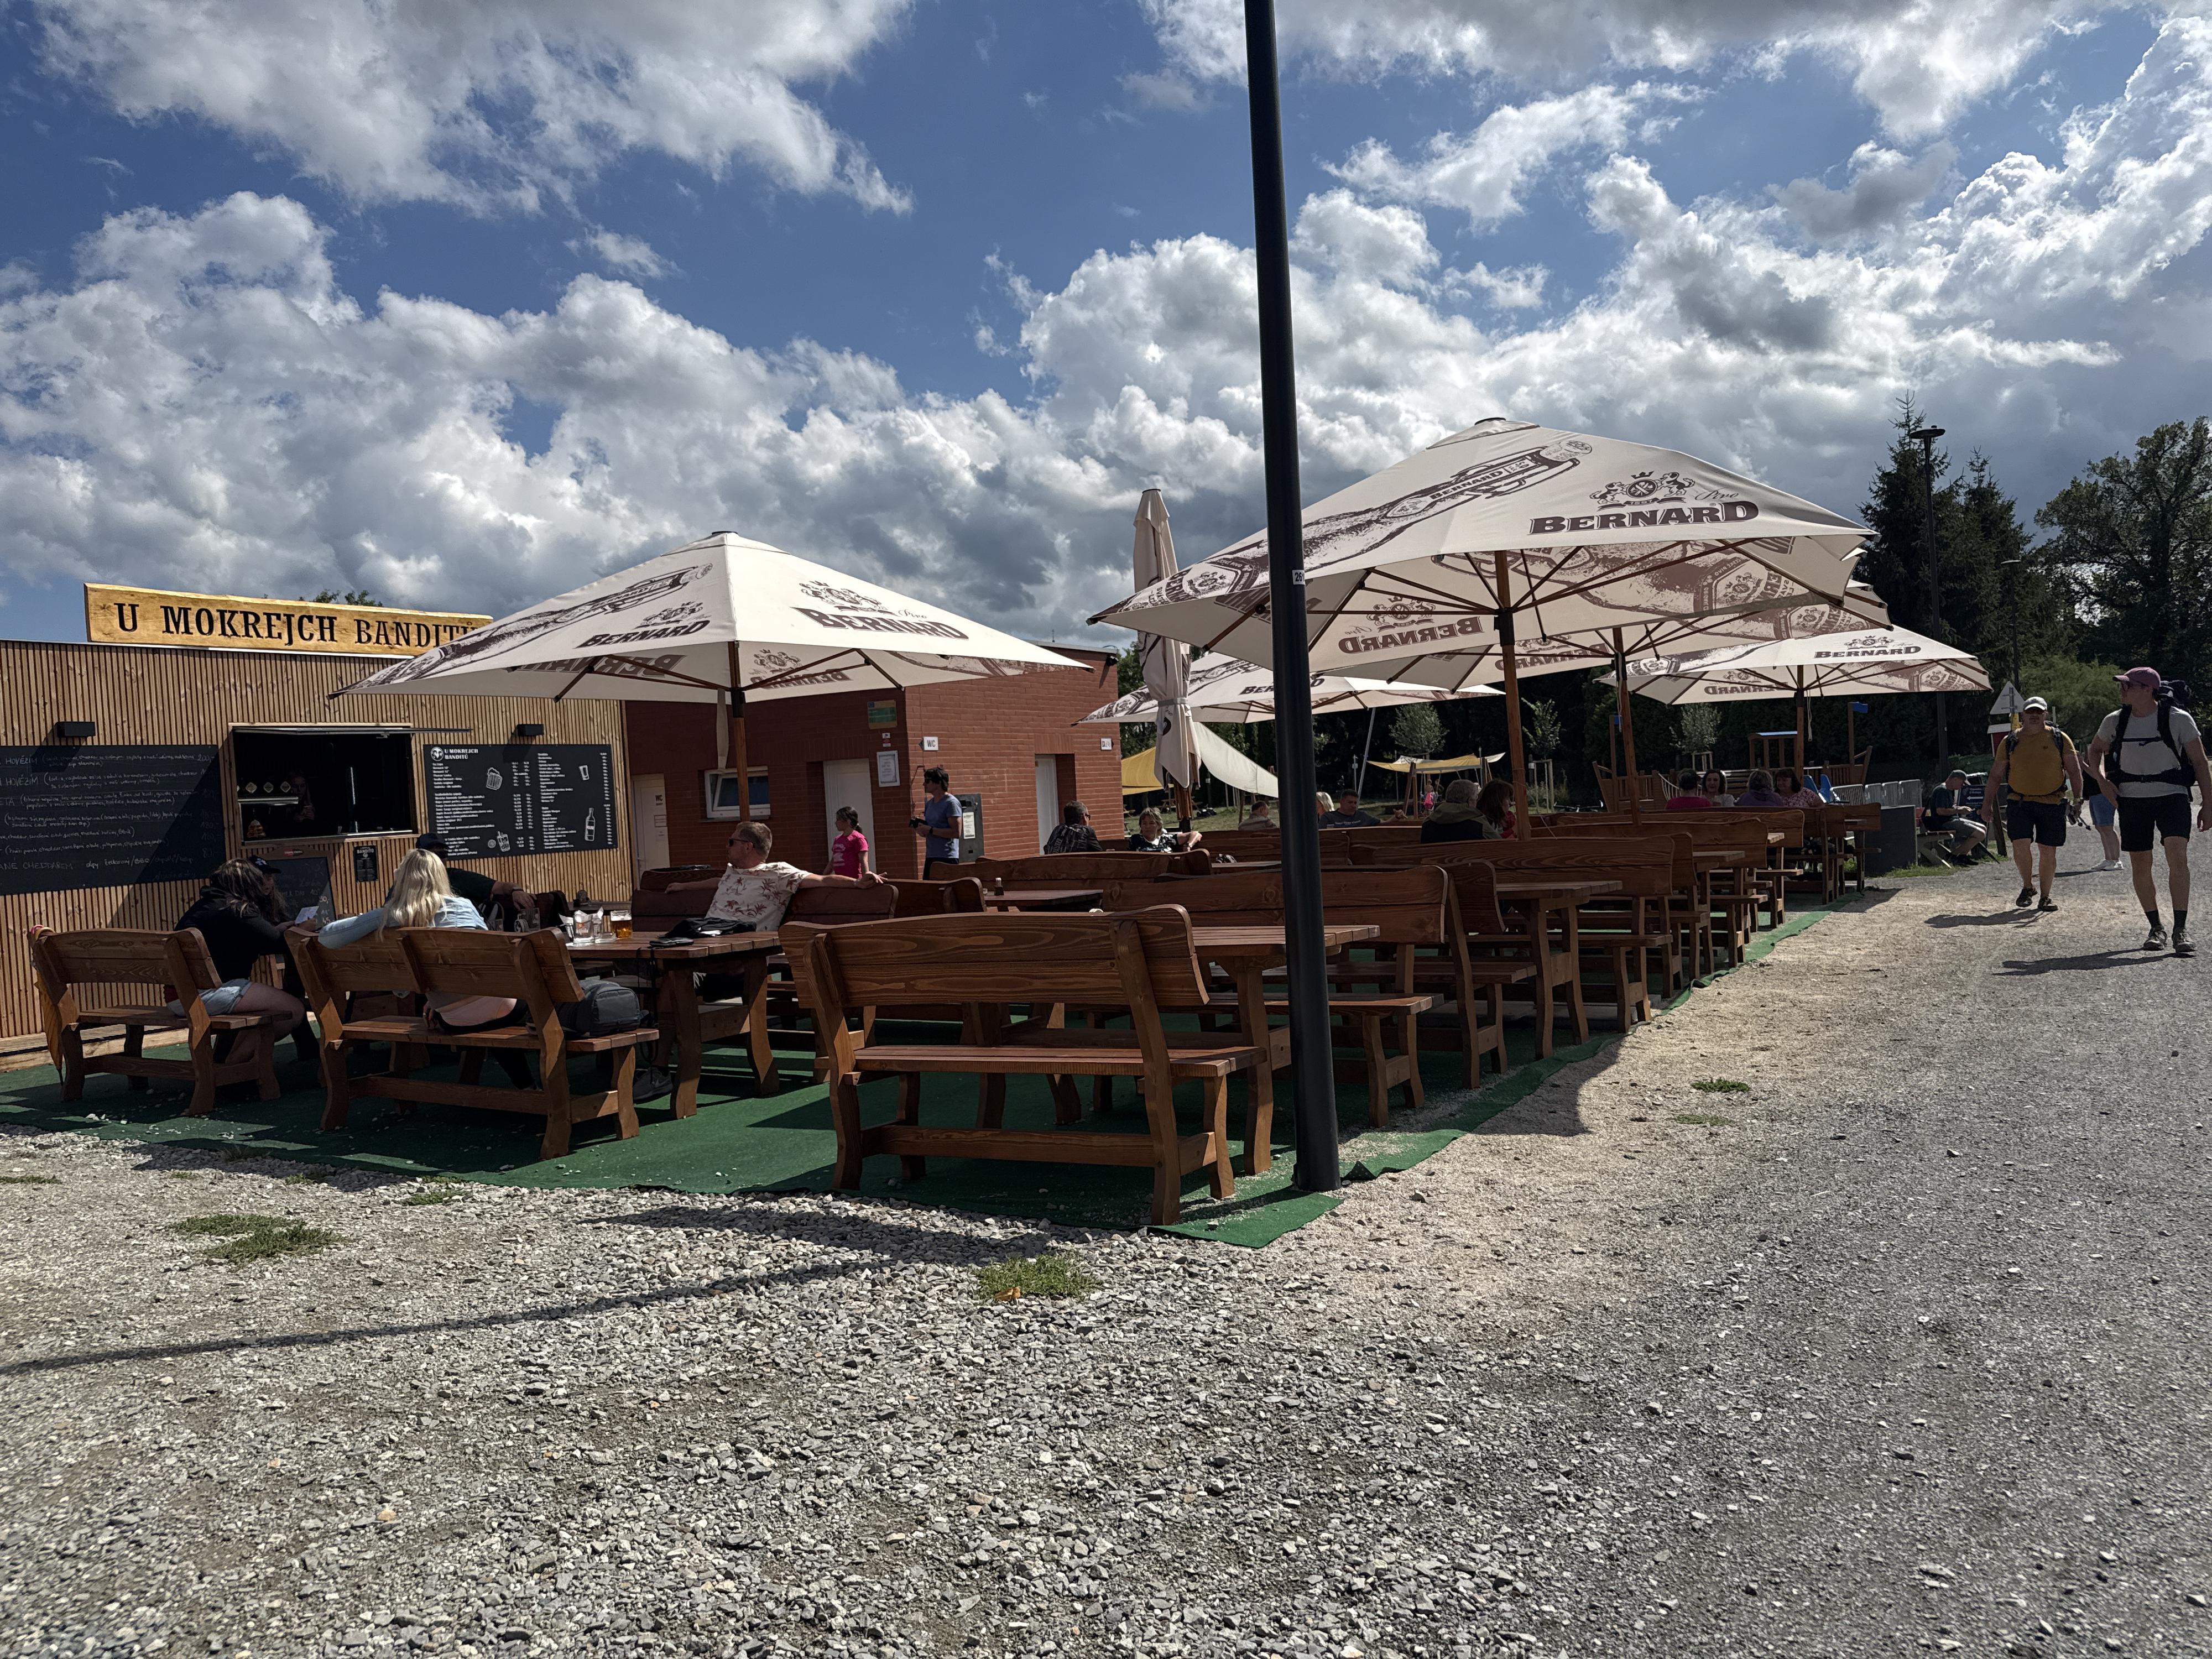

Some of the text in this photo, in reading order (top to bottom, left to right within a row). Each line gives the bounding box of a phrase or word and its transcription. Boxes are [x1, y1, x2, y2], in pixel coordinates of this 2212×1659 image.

[1430, 470, 1504, 500] BERNARD
[1695, 488, 1739, 501] Pivo
[1527, 500, 1759, 535] BERNARD
[113, 602, 138, 632] U
[160, 605, 337, 646] MOKREJCH
[789, 607, 969, 639] BERNARD
[899, 609, 928, 618] Pivo
[572, 620, 711, 649] BERNARD
[1814, 645, 1922, 659] BERNARD
[927, 739, 936, 748] WC
[5, 774, 39, 786] HOVĚZÍM
